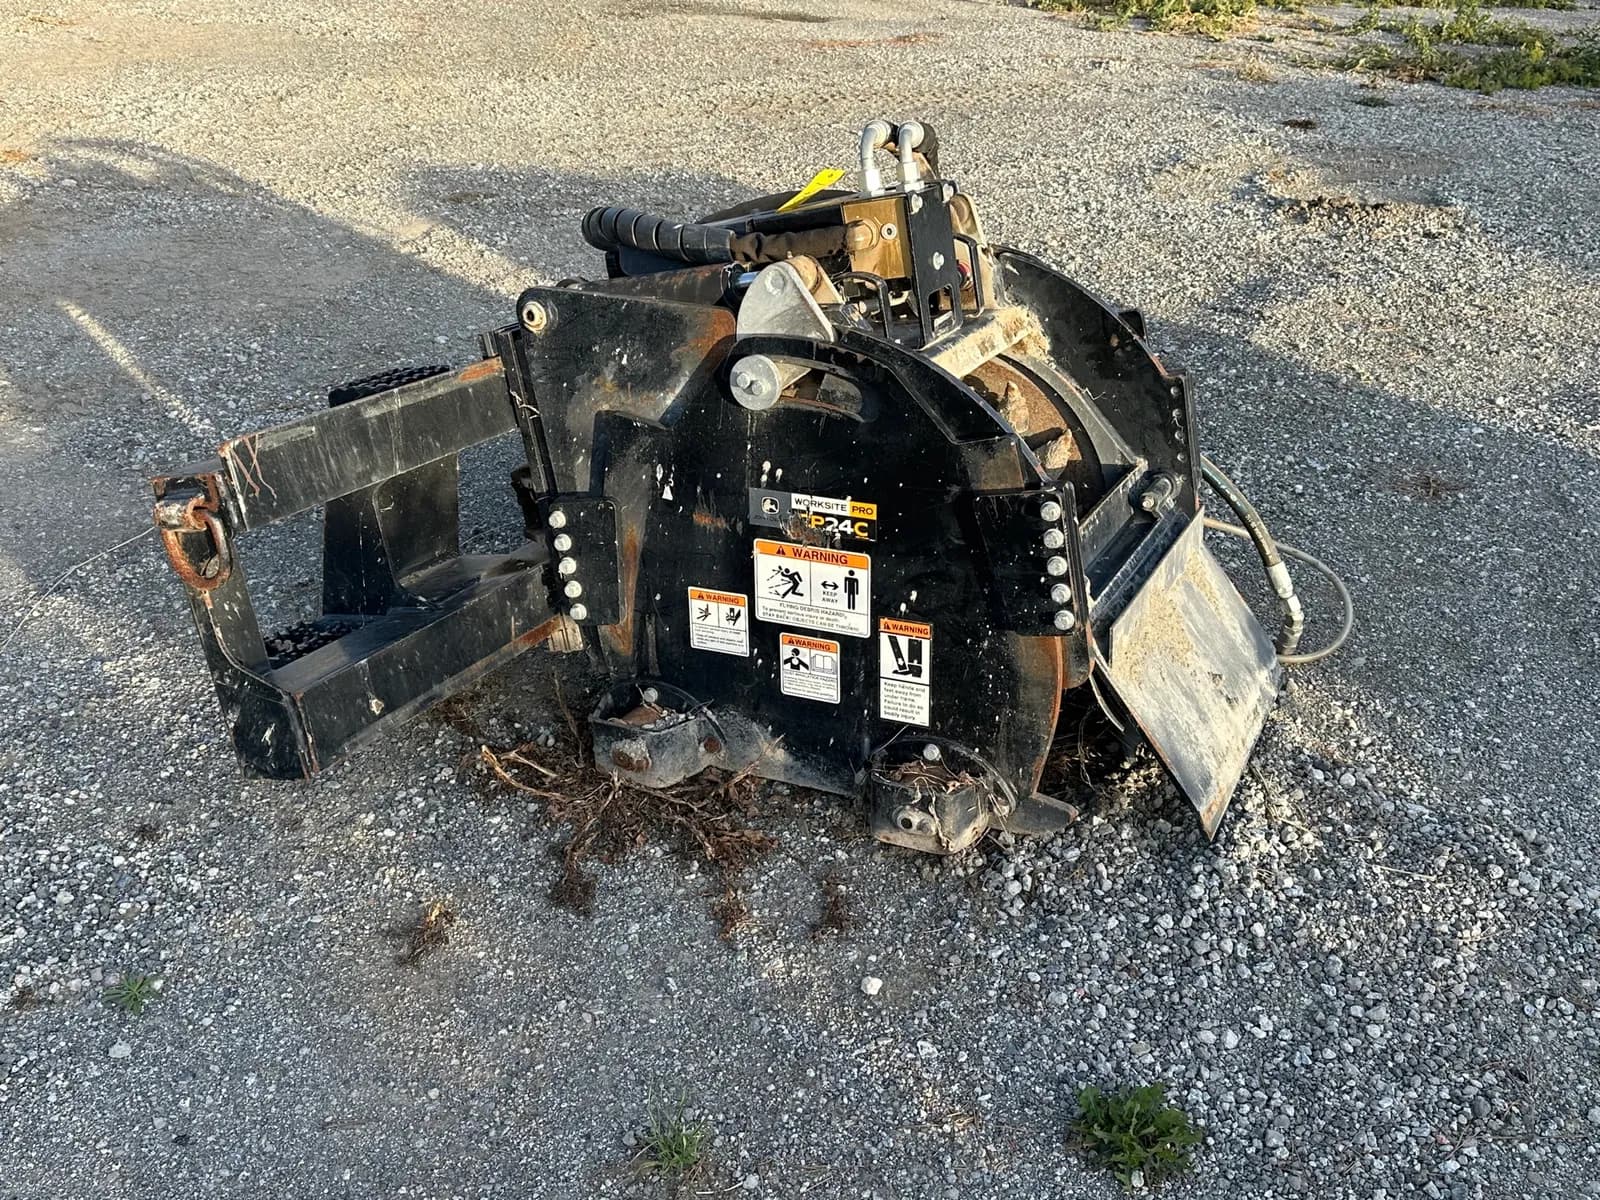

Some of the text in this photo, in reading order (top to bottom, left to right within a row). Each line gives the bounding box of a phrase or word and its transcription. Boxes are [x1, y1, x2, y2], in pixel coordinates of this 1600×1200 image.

[794, 497, 874, 516] WORKSITE PRO
[800, 513, 869, 537] P24C
[792, 547, 849, 565] WARNING
[706, 593, 739, 605] WARNING
[779, 603, 799, 611] FLYING
[892, 623, 929, 635] WARNING
[794, 639, 831, 651] WARNING
